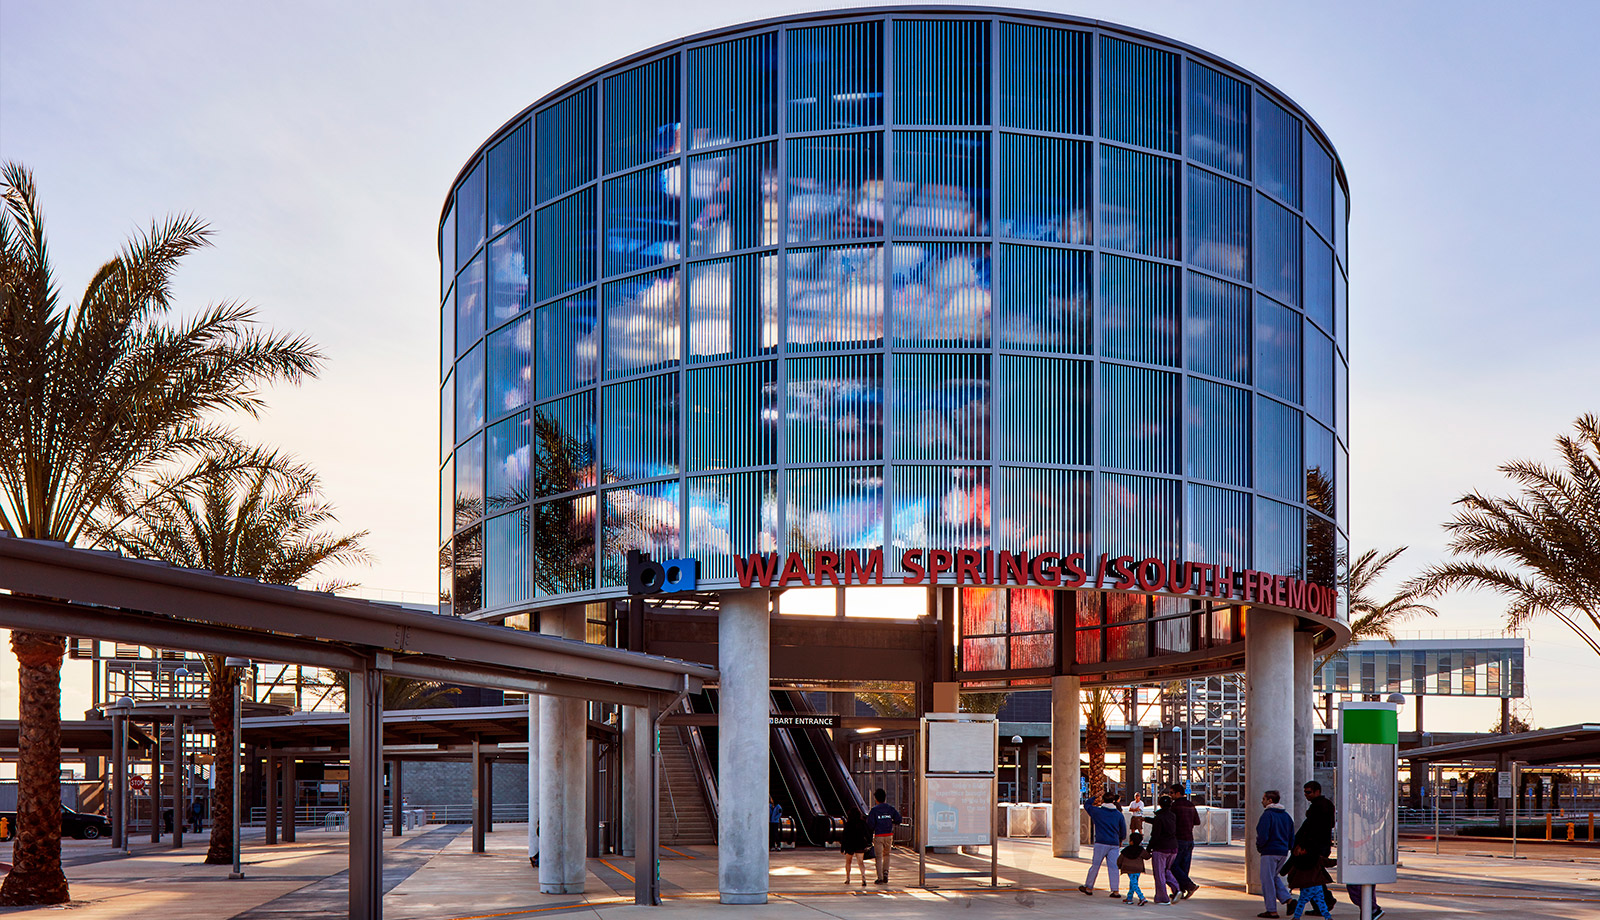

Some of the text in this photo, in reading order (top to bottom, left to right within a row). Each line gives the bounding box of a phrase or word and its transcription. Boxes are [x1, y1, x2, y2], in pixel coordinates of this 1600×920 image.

[733, 550, 883, 587] WARM
[903, 549, 1086, 587] SPRINGS
[1243, 569, 1338, 618] FREMONT
[795, 717, 833, 725] ENTRANCE
